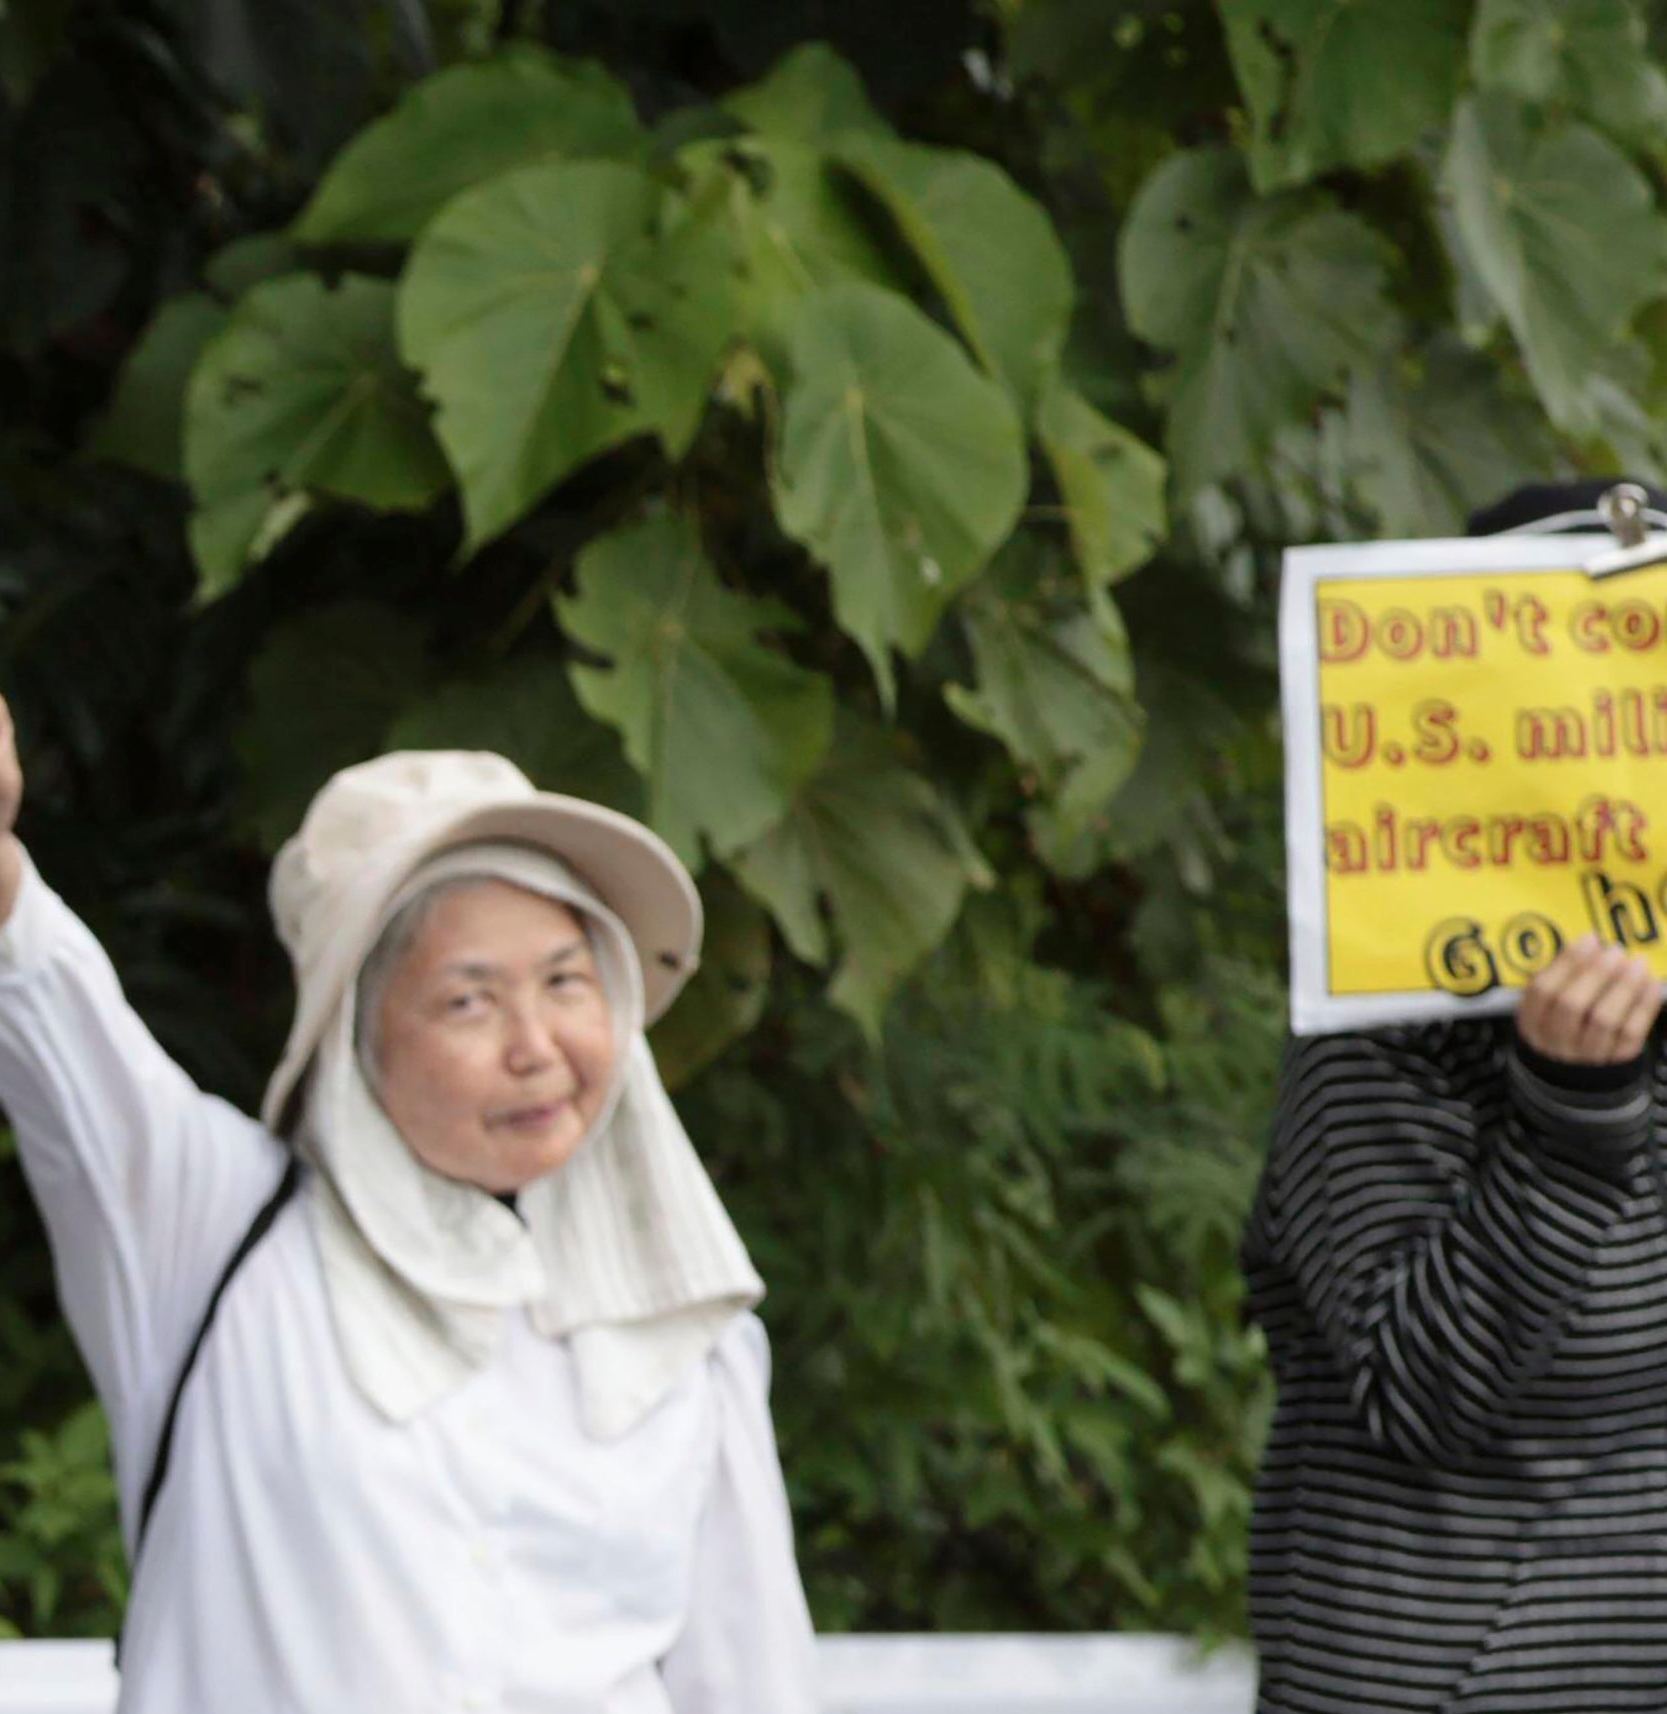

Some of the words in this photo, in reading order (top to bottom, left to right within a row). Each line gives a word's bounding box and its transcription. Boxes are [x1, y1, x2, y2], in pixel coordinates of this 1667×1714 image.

[1318, 588, 1551, 664] Don't
[1567, 598, 1667, 654] co
[1320, 699, 1491, 769] U.S.
[1325, 793, 1649, 875] aircraft
[1581, 867, 1667, 947] h
